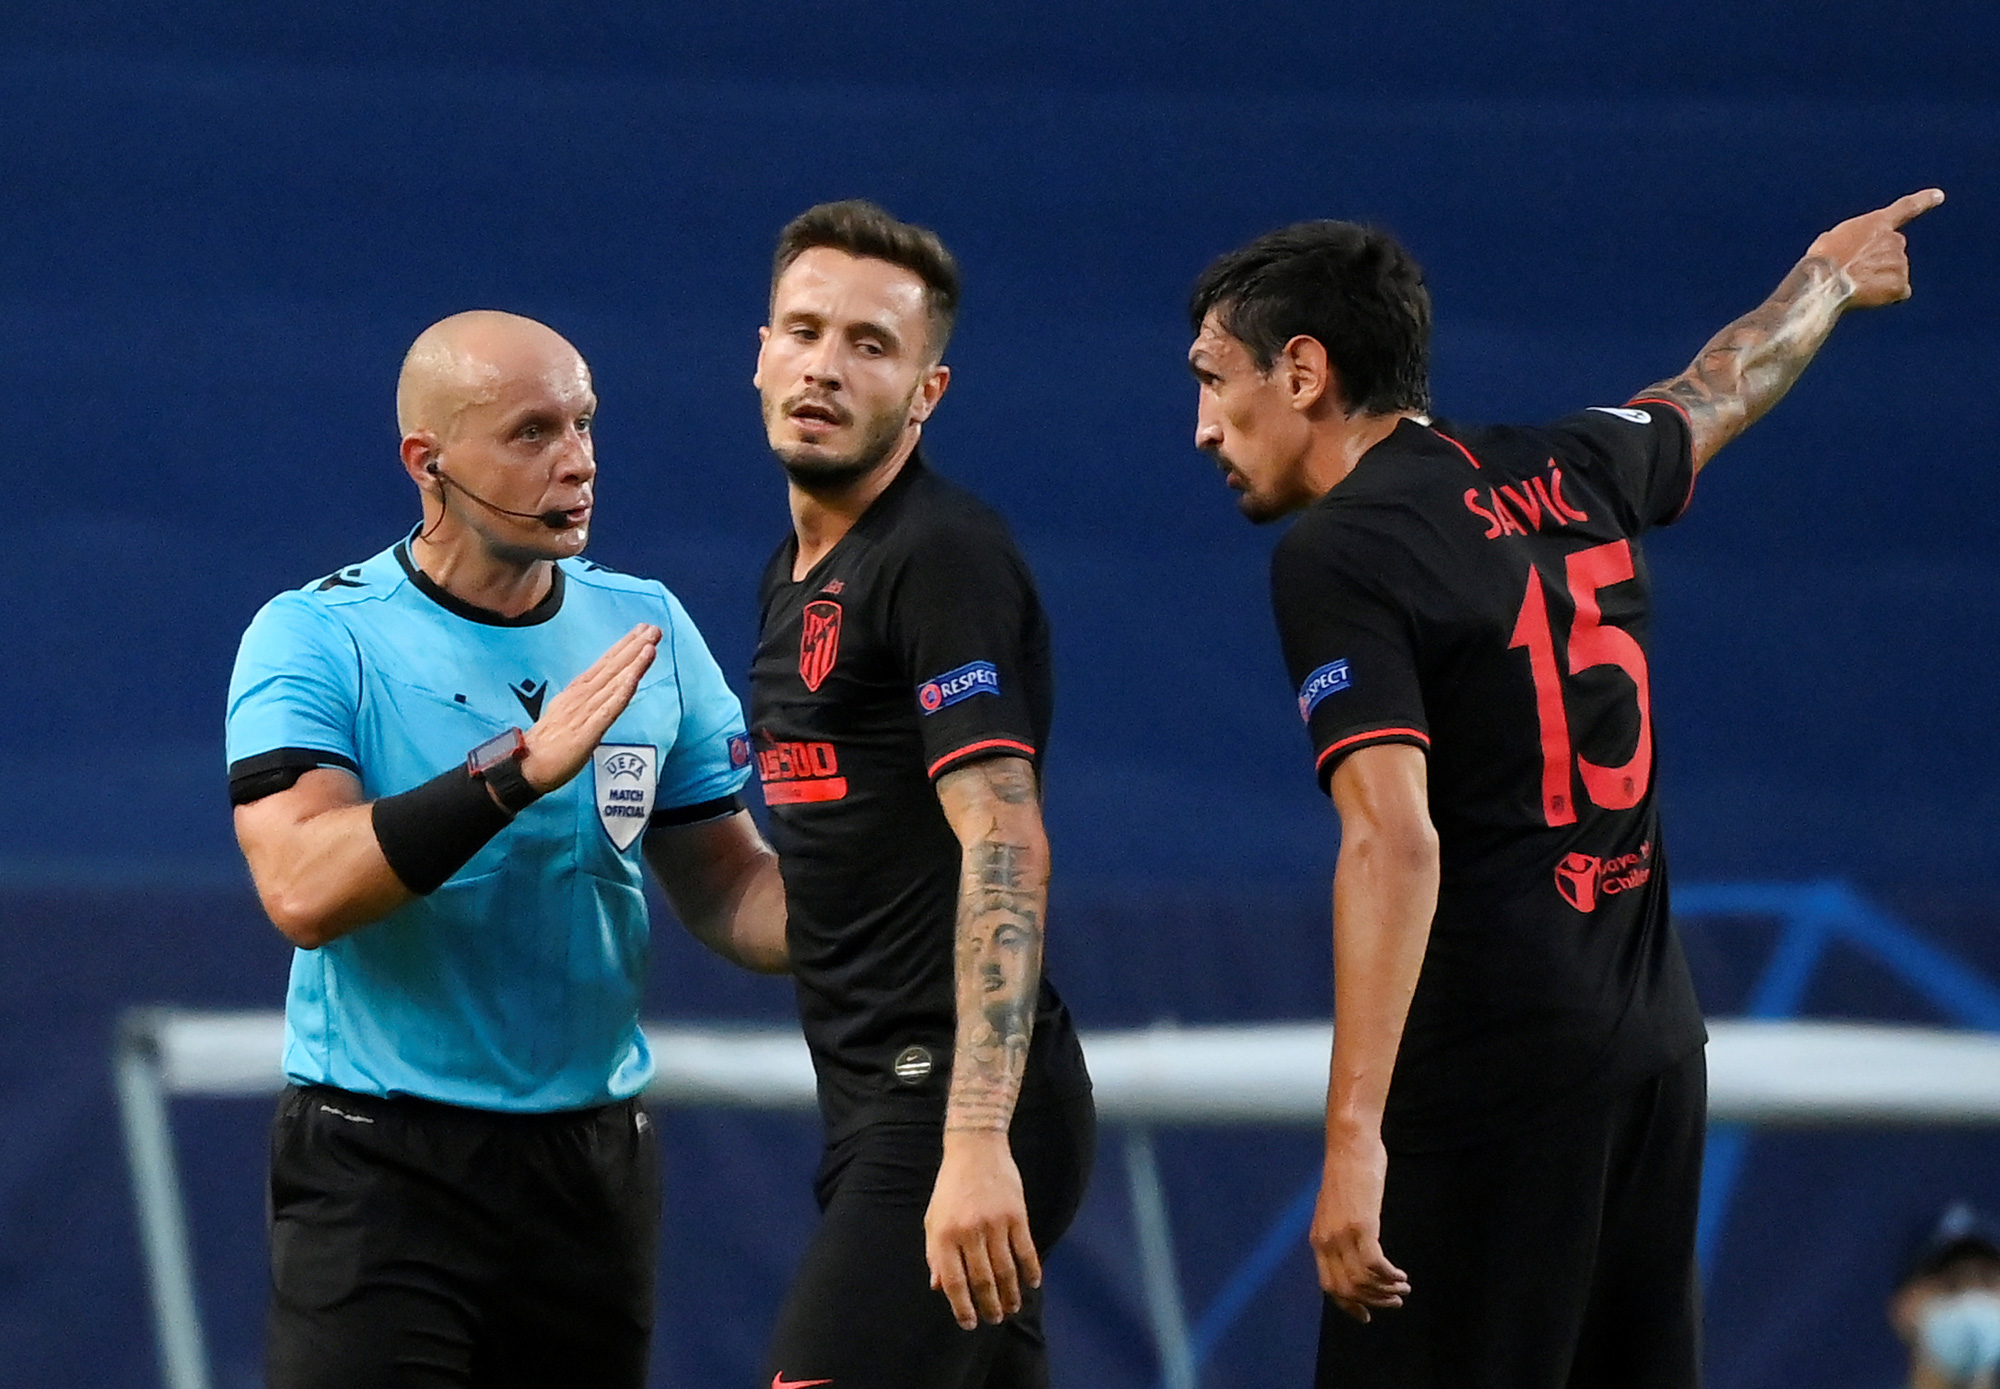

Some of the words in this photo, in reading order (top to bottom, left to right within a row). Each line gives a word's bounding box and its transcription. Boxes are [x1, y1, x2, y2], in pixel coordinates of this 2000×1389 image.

[1464, 457, 1588, 539] SAVIĆ
[941, 669, 997, 697] RESPECT
[1507, 538, 1651, 827] 15
[606, 757, 643, 777] UEFA
[609, 789, 644, 801] MATCH
[604, 805, 645, 818] OFFICIAL
